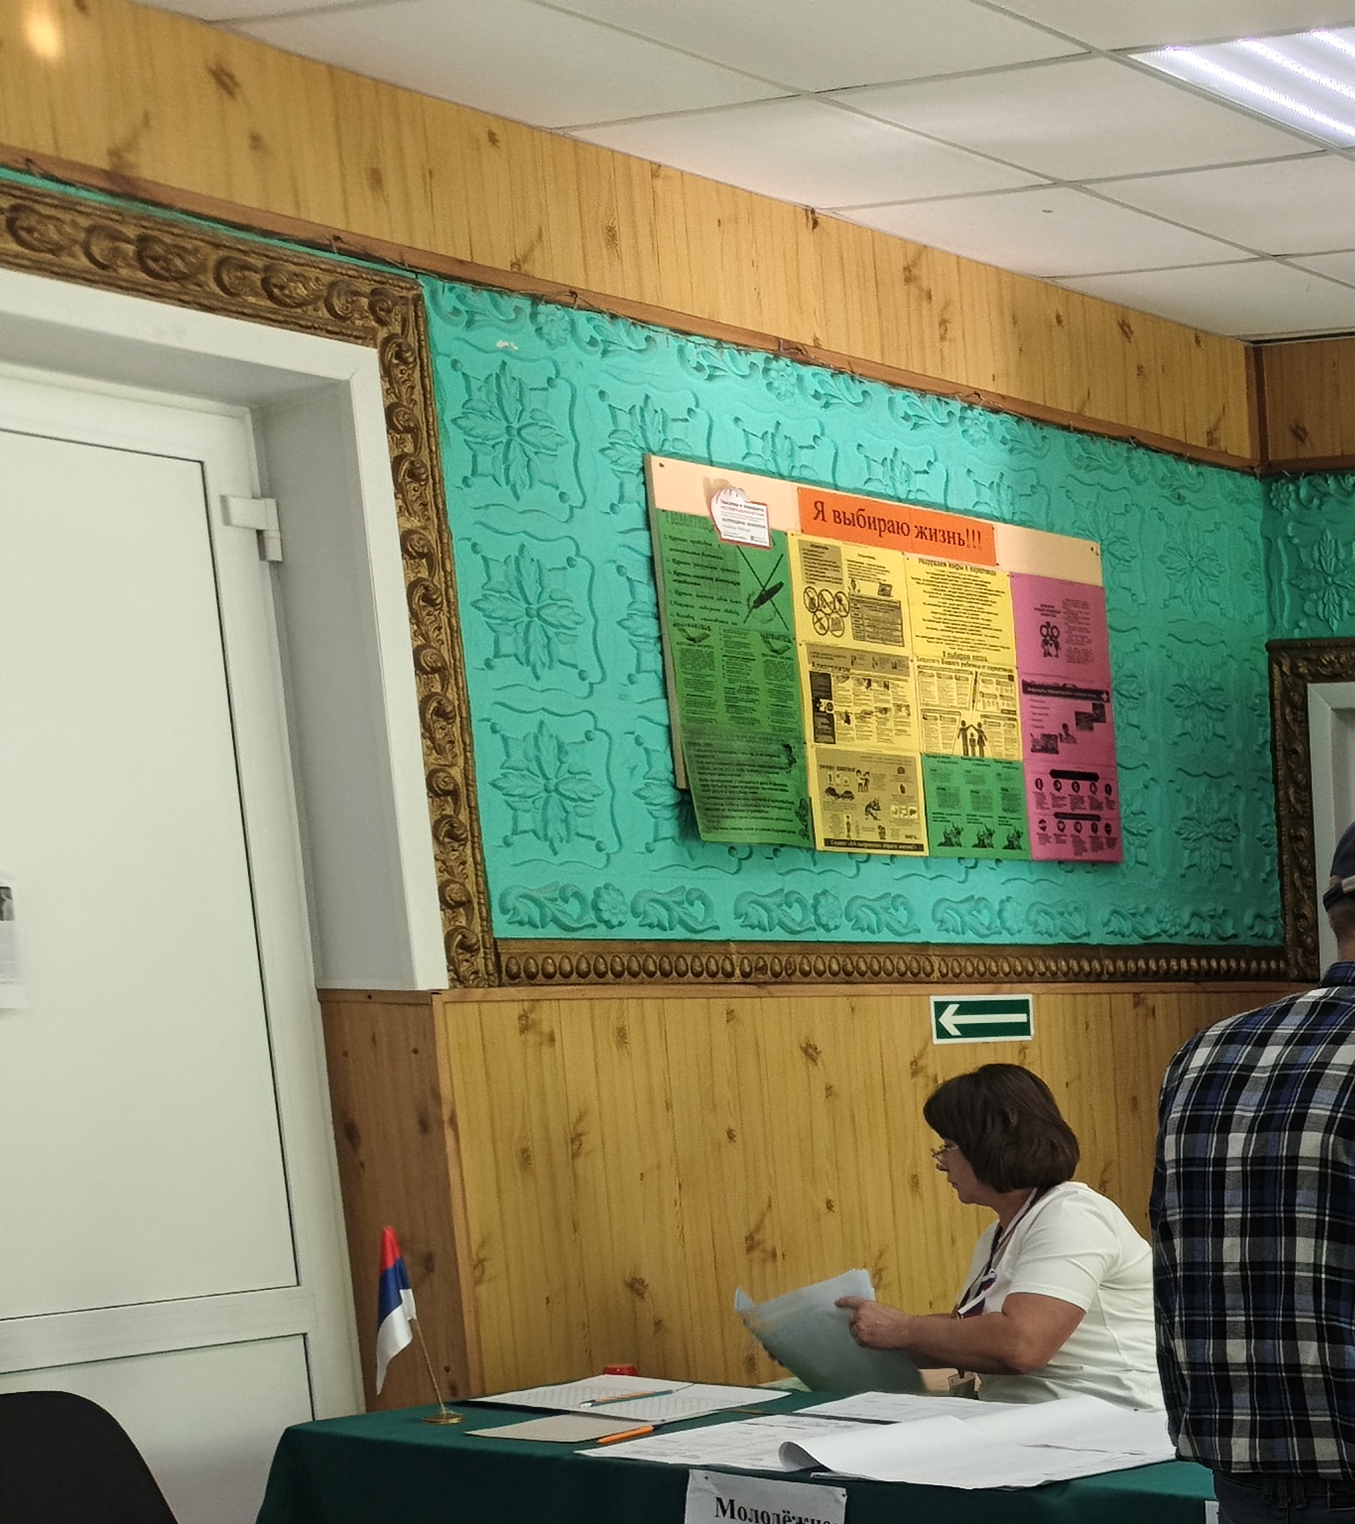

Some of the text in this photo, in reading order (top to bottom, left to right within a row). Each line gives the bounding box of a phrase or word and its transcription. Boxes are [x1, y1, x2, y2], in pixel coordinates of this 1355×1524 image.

[812, 500, 983, 551] Я выбираю жизнь!!!
